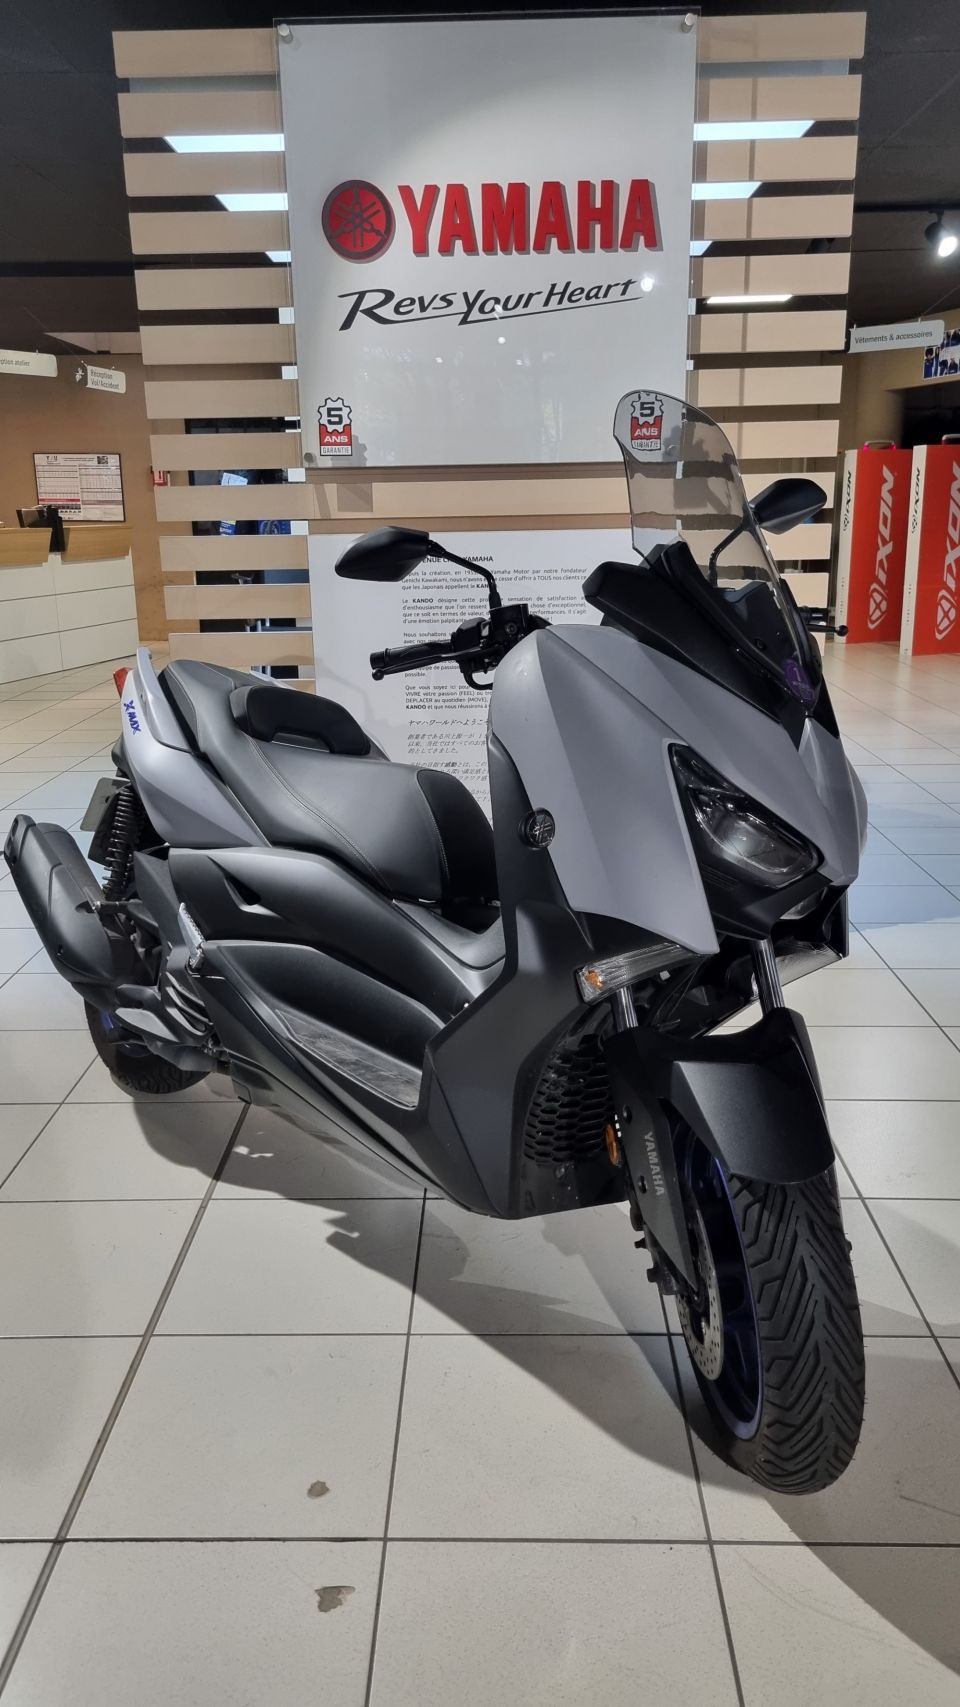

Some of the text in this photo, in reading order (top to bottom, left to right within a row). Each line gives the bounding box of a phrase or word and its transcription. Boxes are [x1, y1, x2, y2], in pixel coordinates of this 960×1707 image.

[397, 179, 663, 257] YAMAHA
[337, 278, 638, 331] Revs Your Heart
[854, 335, 888, 344] Vêtements
[896, 331, 932, 340] accessoires
[326, 407, 343, 425] 5
[640, 402, 655, 417] 5
[634, 428, 658, 437] ANS
[644, 1131, 664, 1196] YAMAHA
